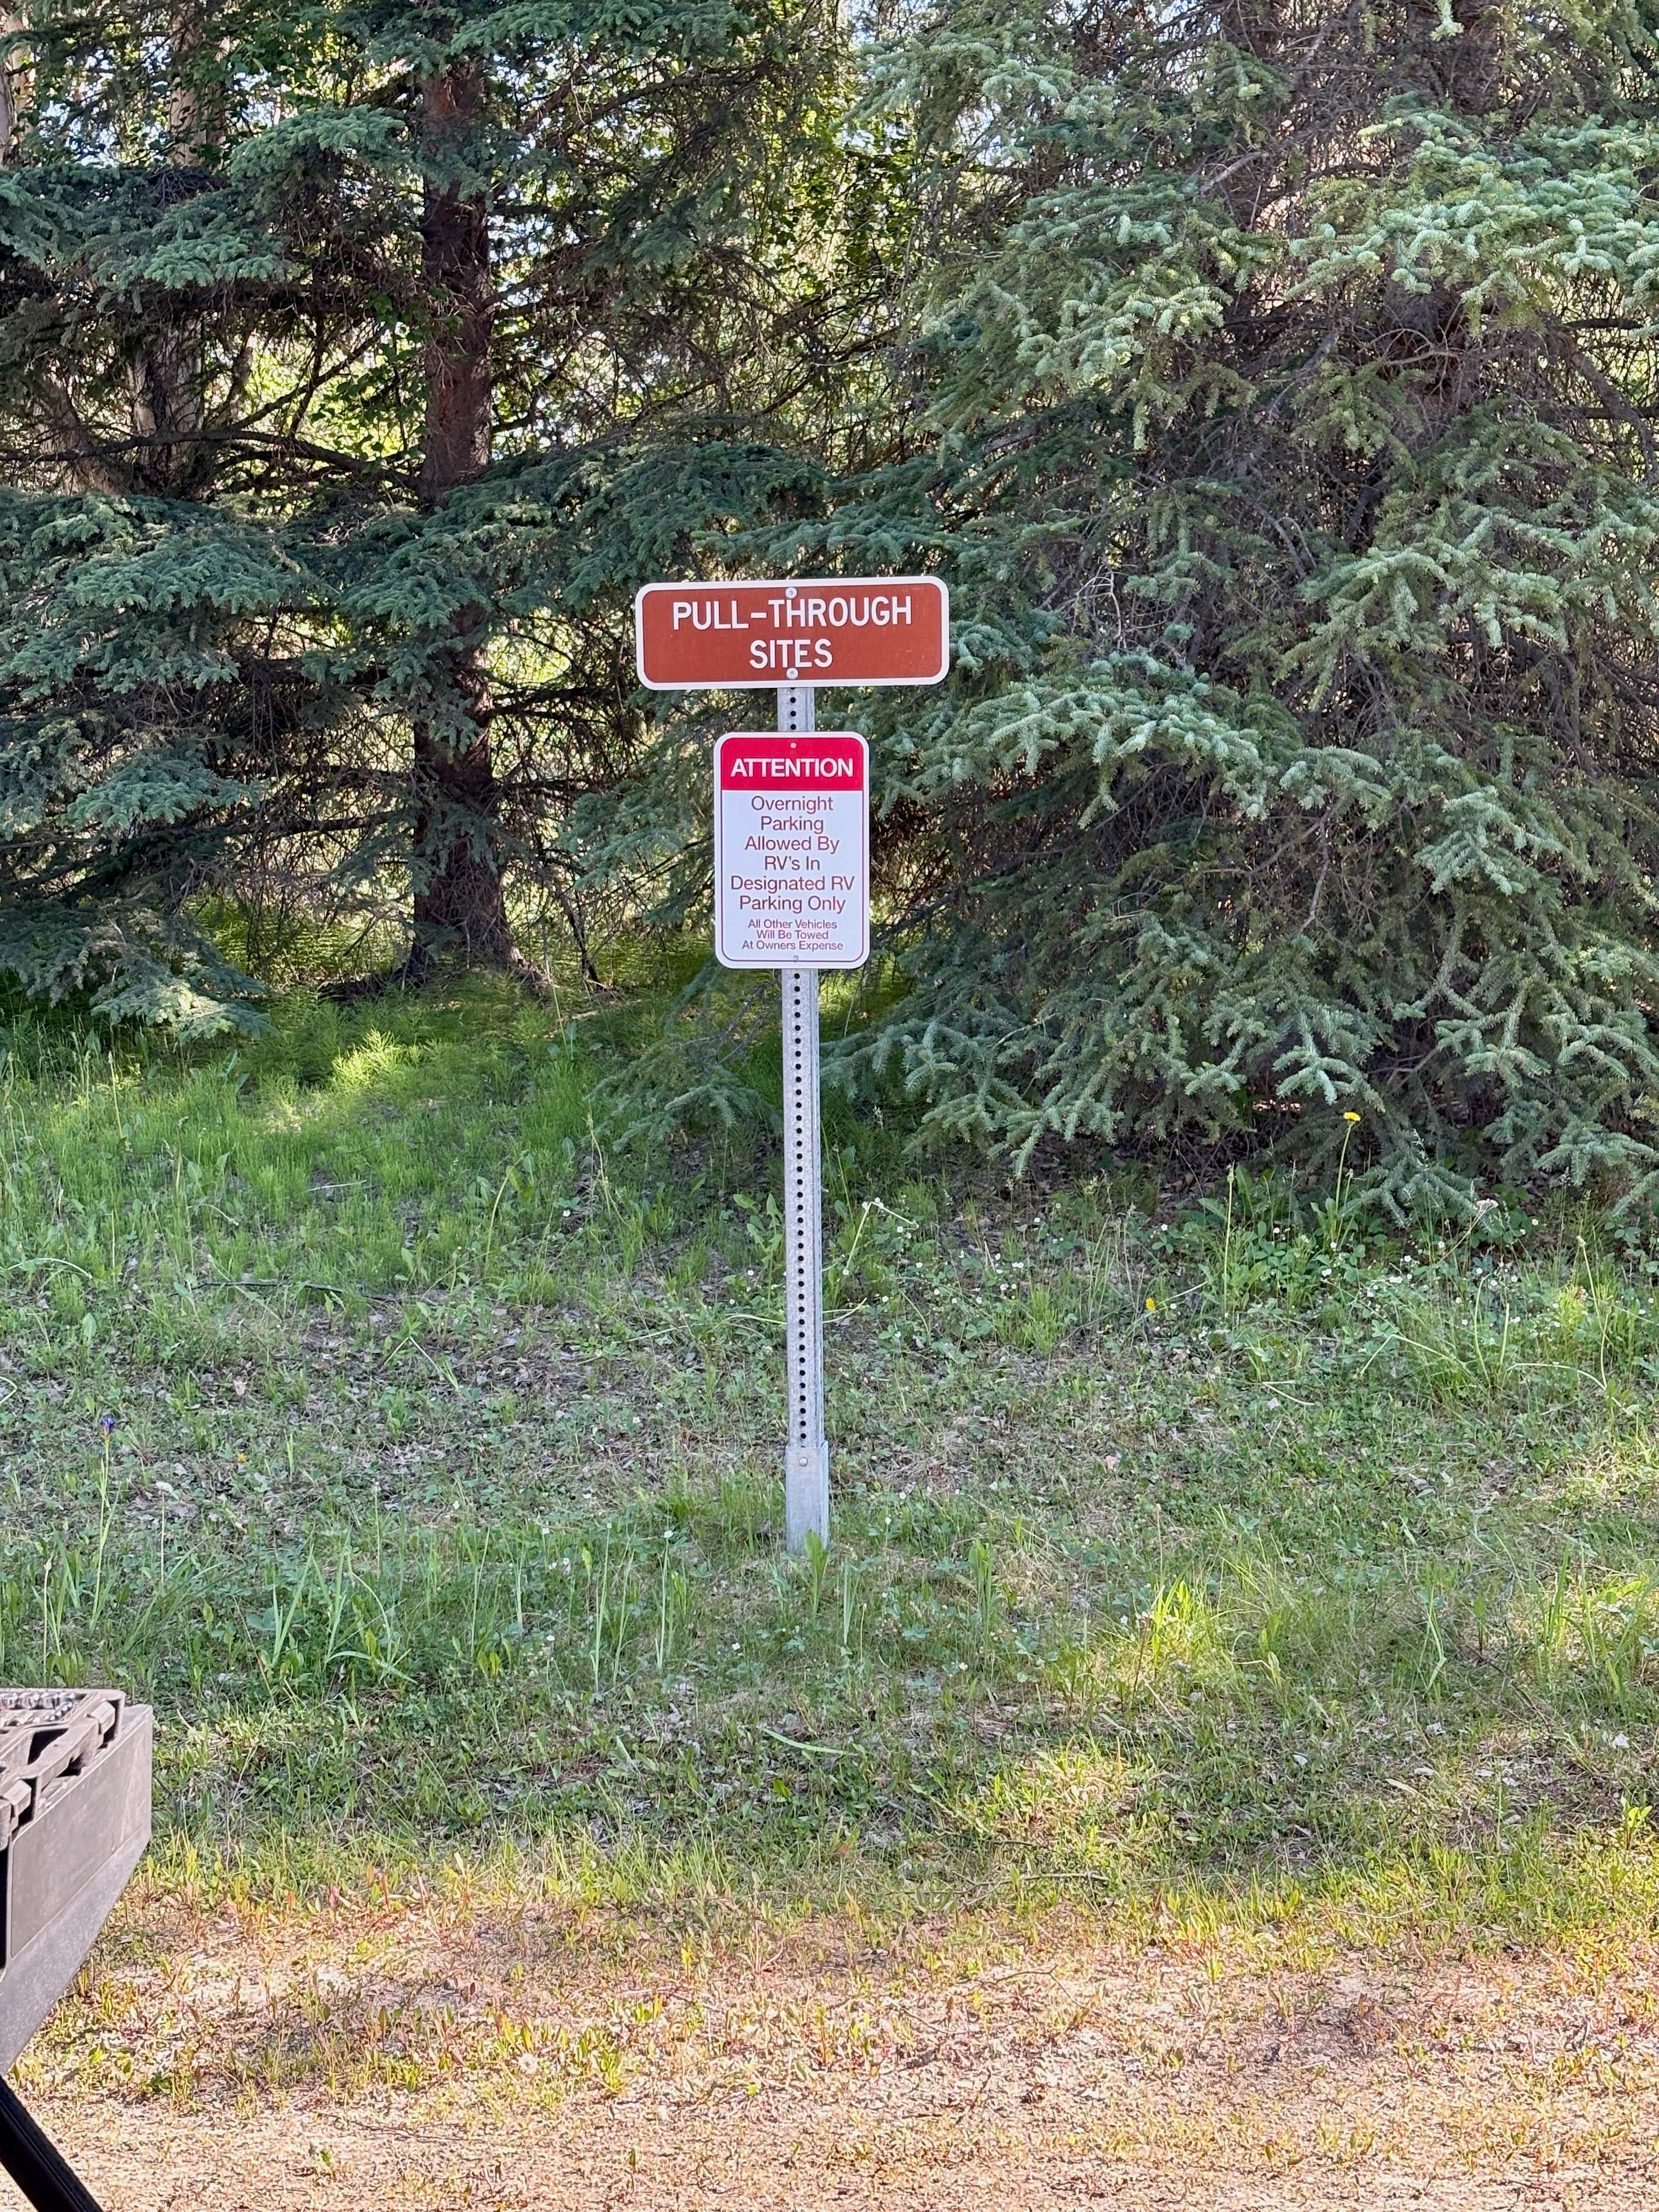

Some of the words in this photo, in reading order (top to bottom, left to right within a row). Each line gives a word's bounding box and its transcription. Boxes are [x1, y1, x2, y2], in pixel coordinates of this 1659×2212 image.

[673, 596, 912, 630] PULL-THROUGH
[749, 639, 833, 669] SITES
[730, 758, 853, 777] ATTENTION
[752, 795, 833, 814] Overnight
[761, 816, 824, 834] Parking
[744, 836, 812, 851] Allowed
[818, 836, 839, 854] By
[764, 856, 800, 871] RV's
[806, 857, 820, 871] In
[731, 876, 825, 893] Designated
[832, 876, 855, 891] RV
[740, 895, 803, 913] Parking
[808, 896, 846, 914] Only
[748, 919, 762, 929] All
[764, 919, 793, 929] Other
[795, 919, 837, 929] Vehicles
[757, 930, 775, 939] Will
[778, 930, 792, 939] Be
[794, 930, 828, 939] Towed
[742, 941, 754, 950] At
[756, 941, 795, 950] Owners
[799, 941, 843, 952] Expense
